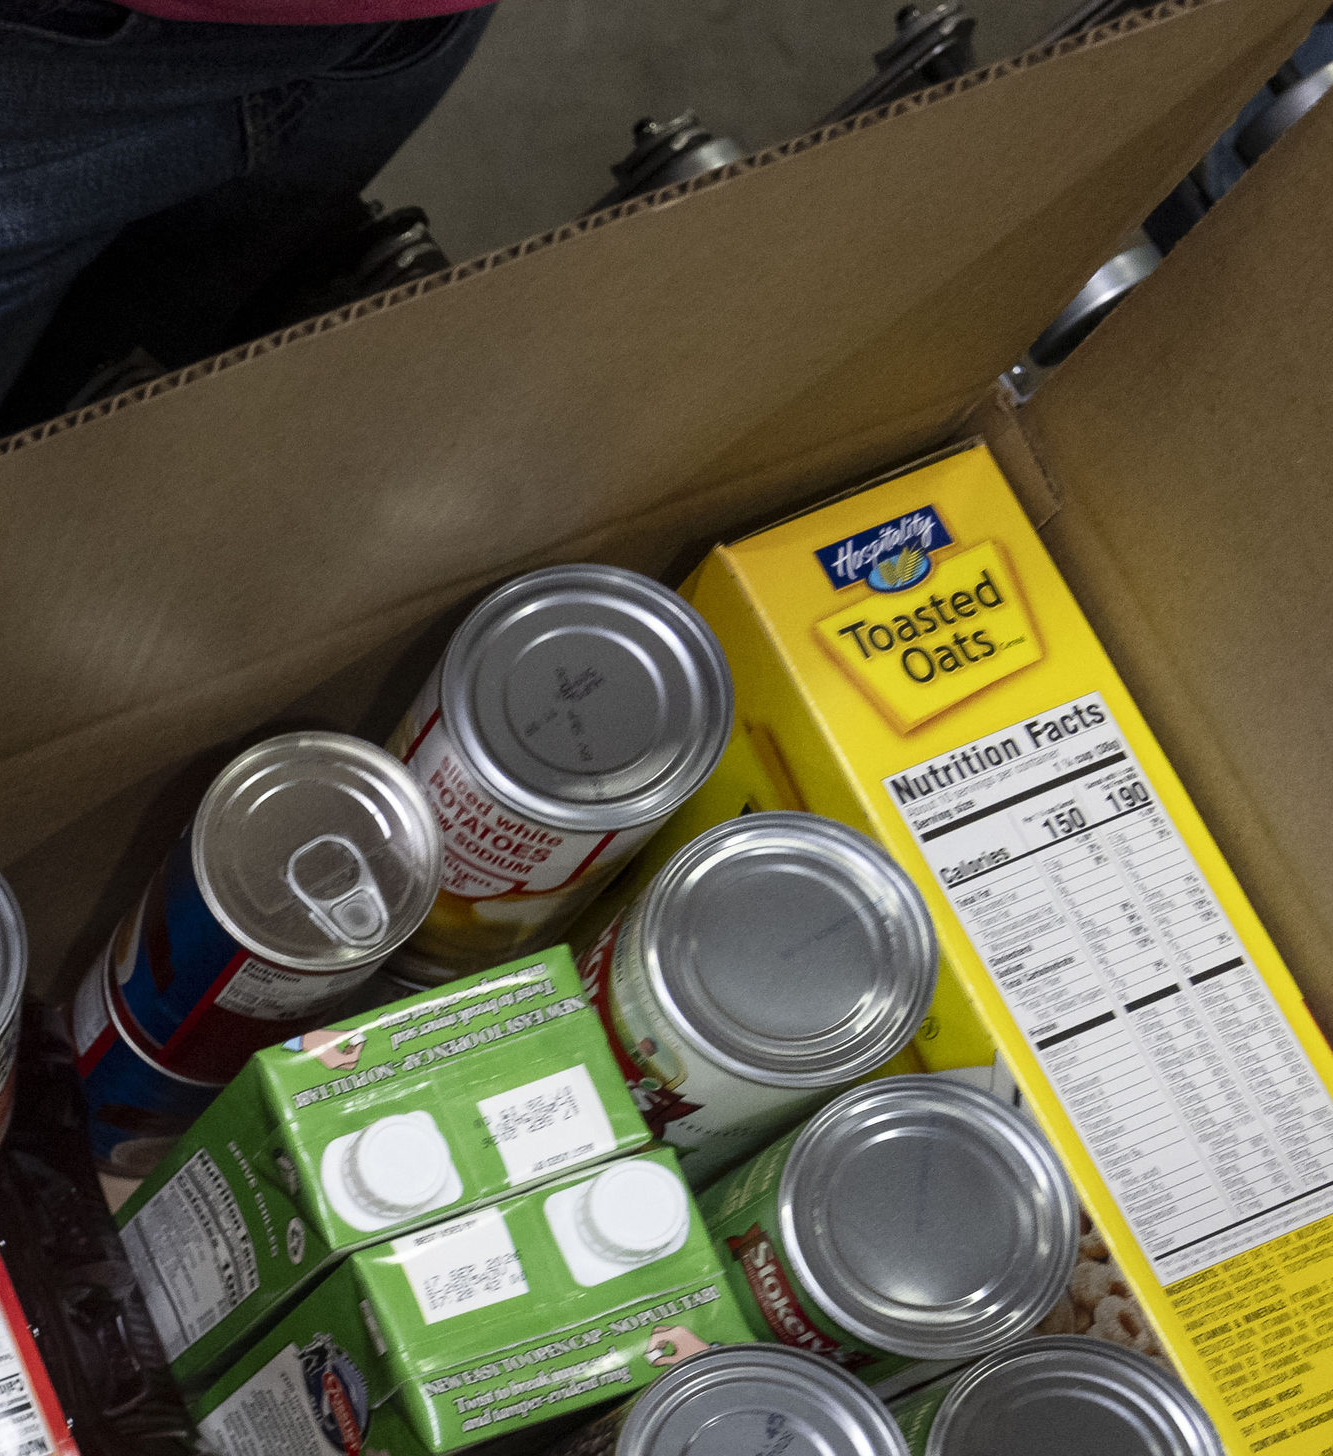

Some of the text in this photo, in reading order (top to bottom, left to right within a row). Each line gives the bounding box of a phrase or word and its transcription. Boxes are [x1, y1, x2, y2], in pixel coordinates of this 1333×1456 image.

[823, 508, 946, 585] Hospitality
[836, 568, 1005, 664] Toasted
[895, 619, 998, 687] Oats
[888, 697, 1108, 806] Nutrition Facts
[429, 770, 547, 866] POTATOES
[491, 813, 566, 849] white
[1040, 779, 1150, 841] 150 190
[450, 830, 534, 878] SODIUM
[937, 843, 1012, 886] Calories
